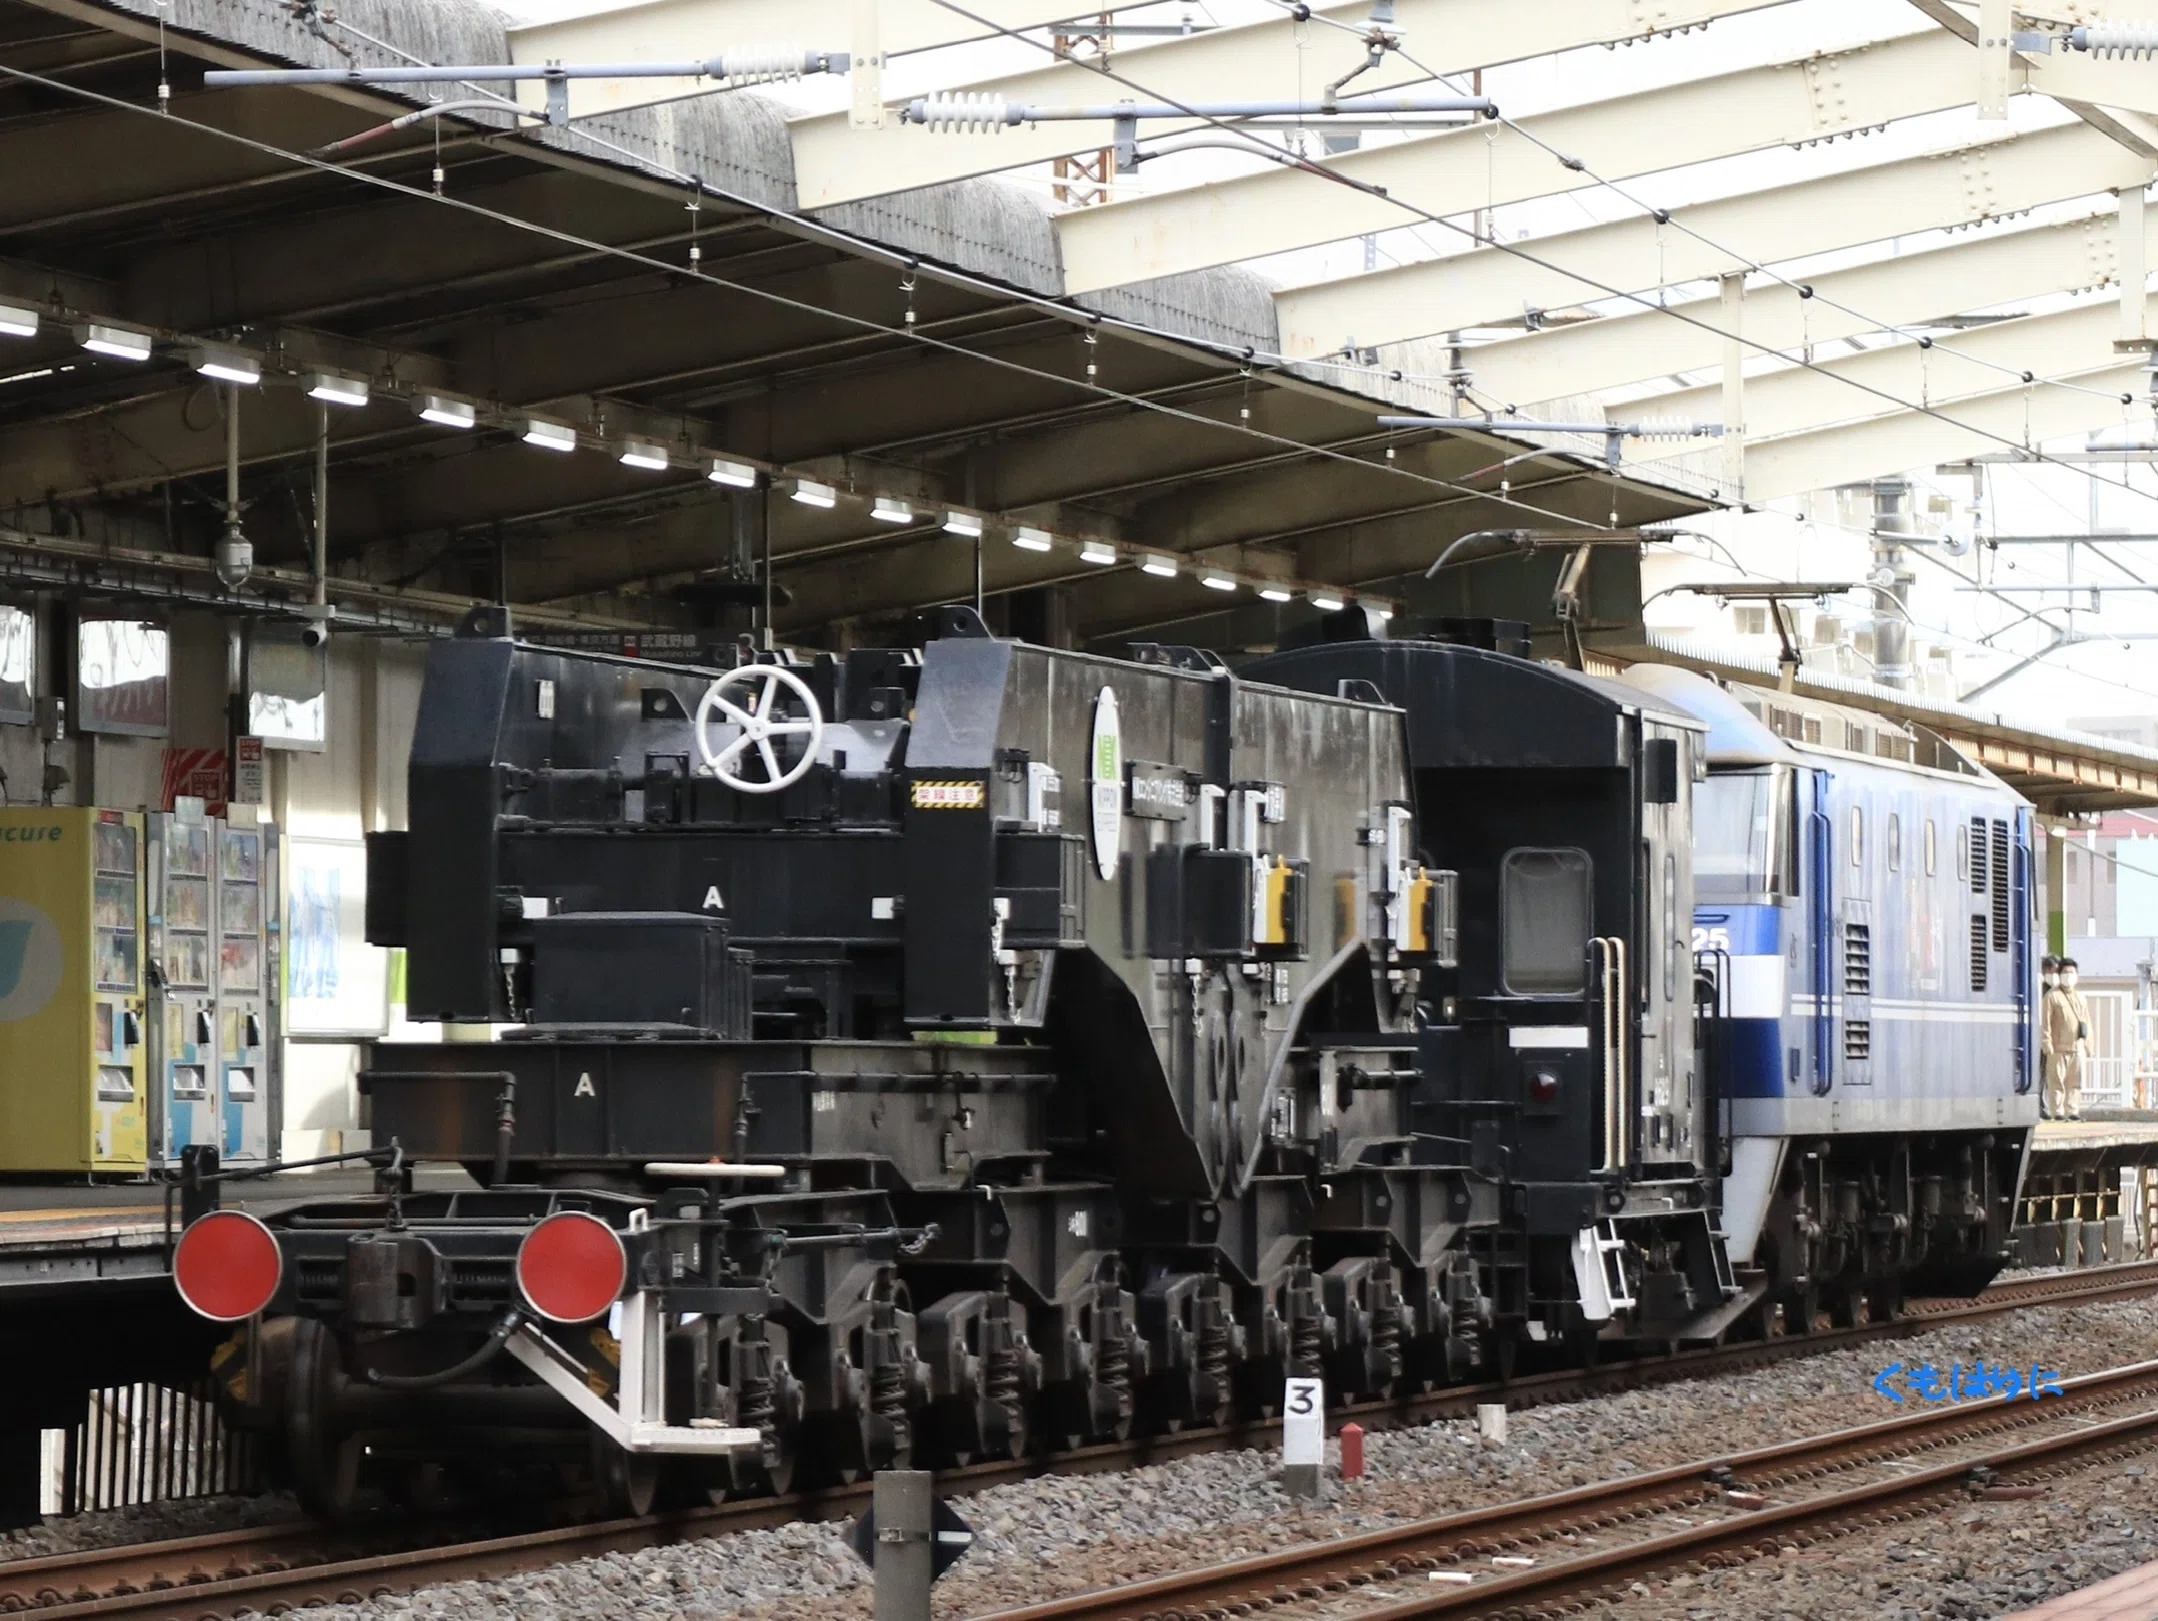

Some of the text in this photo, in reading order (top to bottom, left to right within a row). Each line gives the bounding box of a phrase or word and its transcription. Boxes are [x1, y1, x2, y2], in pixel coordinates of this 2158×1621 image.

[639, 634, 697, 648] 武蔵野線
[0, 825, 64, 842] cure
[702, 885, 725, 909] A
[1691, 927, 1730, 953] 25
[573, 1071, 596, 1097] A
[1287, 1385, 1316, 1415] 3
